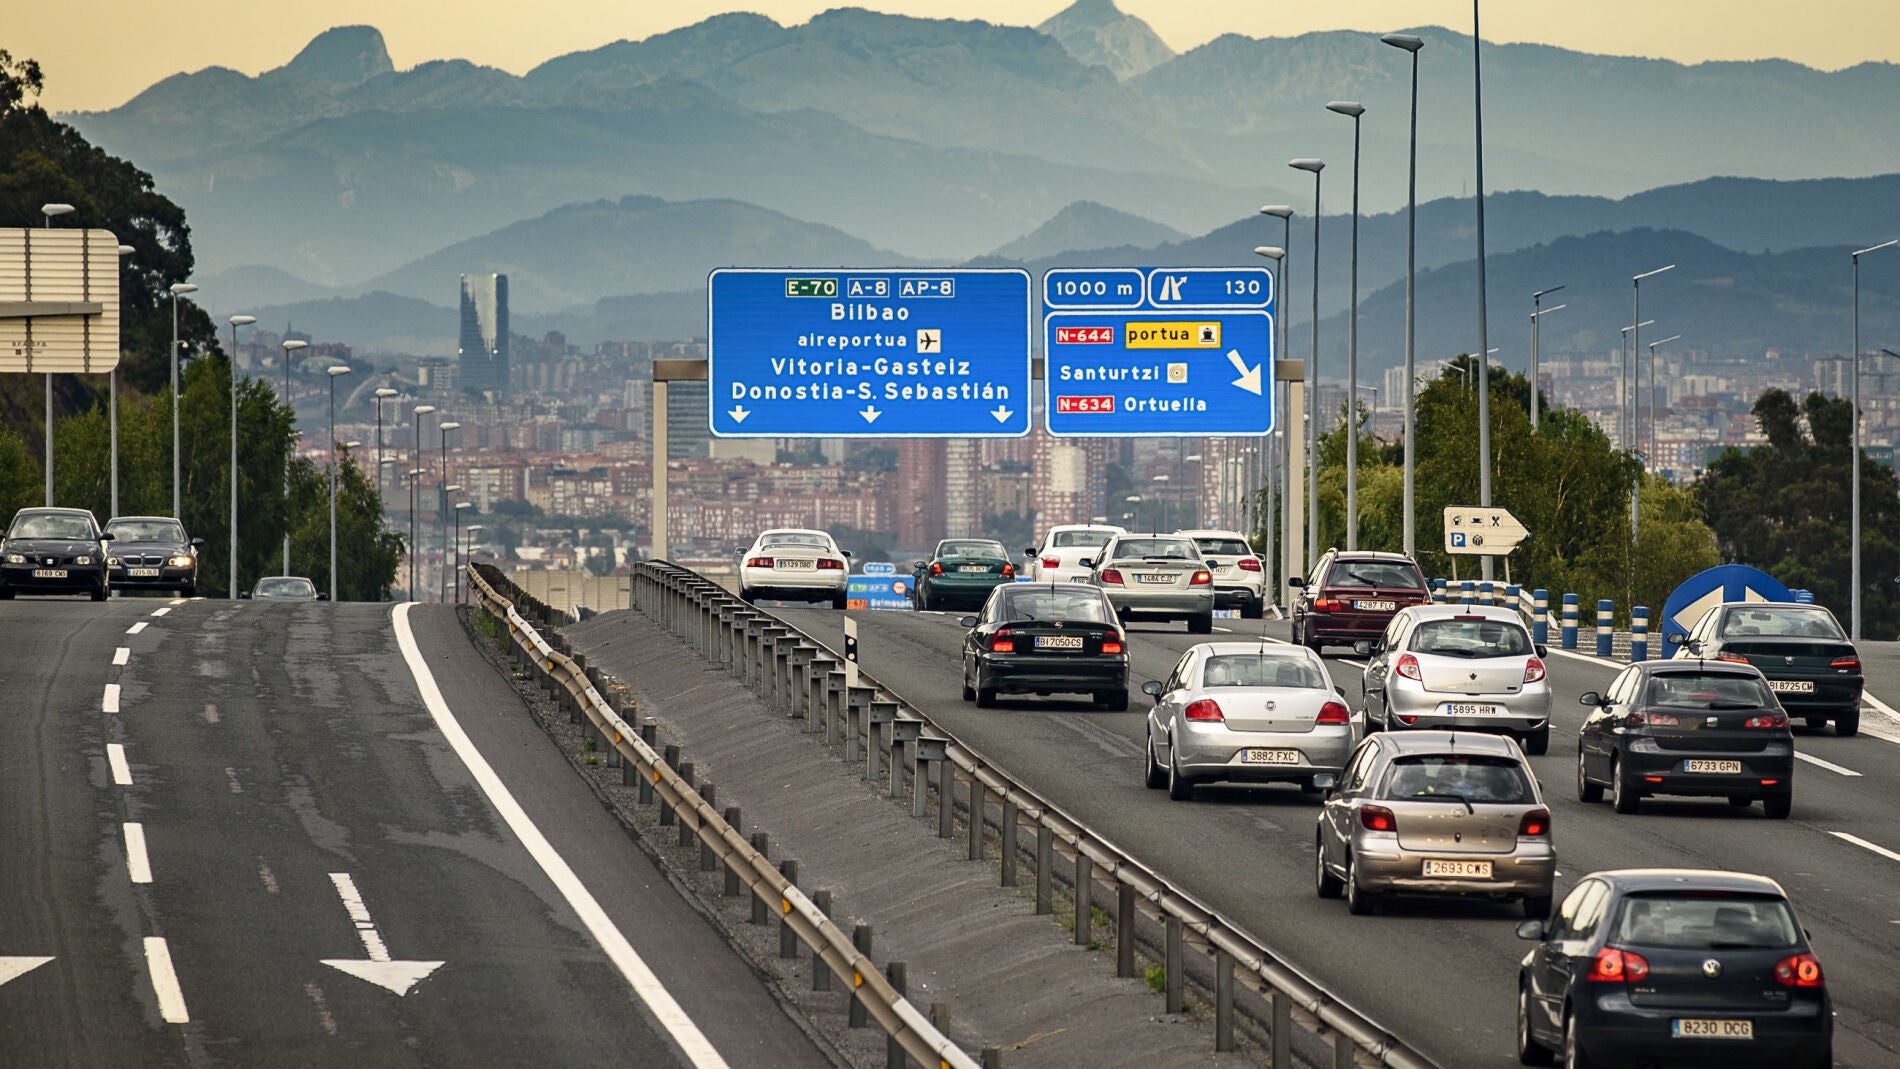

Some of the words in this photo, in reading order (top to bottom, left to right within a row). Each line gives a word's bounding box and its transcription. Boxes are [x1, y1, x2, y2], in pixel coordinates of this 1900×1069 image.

[787, 281, 836, 295] E-70
[849, 281, 887, 295] A-8
[902, 280, 953, 295] AP-8
[1056, 281, 1107, 296] 1000
[1117, 284, 1132, 296] m
[1225, 280, 1260, 295] 130
[831, 303, 910, 321] Bilbao
[798, 332, 907, 351] aireportua
[1058, 329, 1111, 343] N-644
[1129, 326, 1190, 343] portua
[771, 358, 971, 376] Vitoria-Gasteiz
[1060, 366, 1159, 381] Santurtzi
[731, 382, 878, 400] Donostia-S.
[884, 380, 1010, 400] Sebastián
[1059, 397, 1112, 412] N-634
[1125, 397, 1207, 412] Ortuella
[1780, 682, 1801, 690] 8725
[1453, 706, 1476, 714] 5895
[1479, 707, 1496, 715] HRW
[1251, 751, 1274, 761] 3882
[1276, 752, 1295, 761] FXC
[1691, 762, 1717, 771] 6733
[1719, 762, 1739, 771] GPN
[1433, 862, 1463, 874] 2693
[1466, 863, 1489, 875] CWS
[1684, 1022, 1717, 1034] 8230
[1724, 1022, 1749, 1034] DCG
